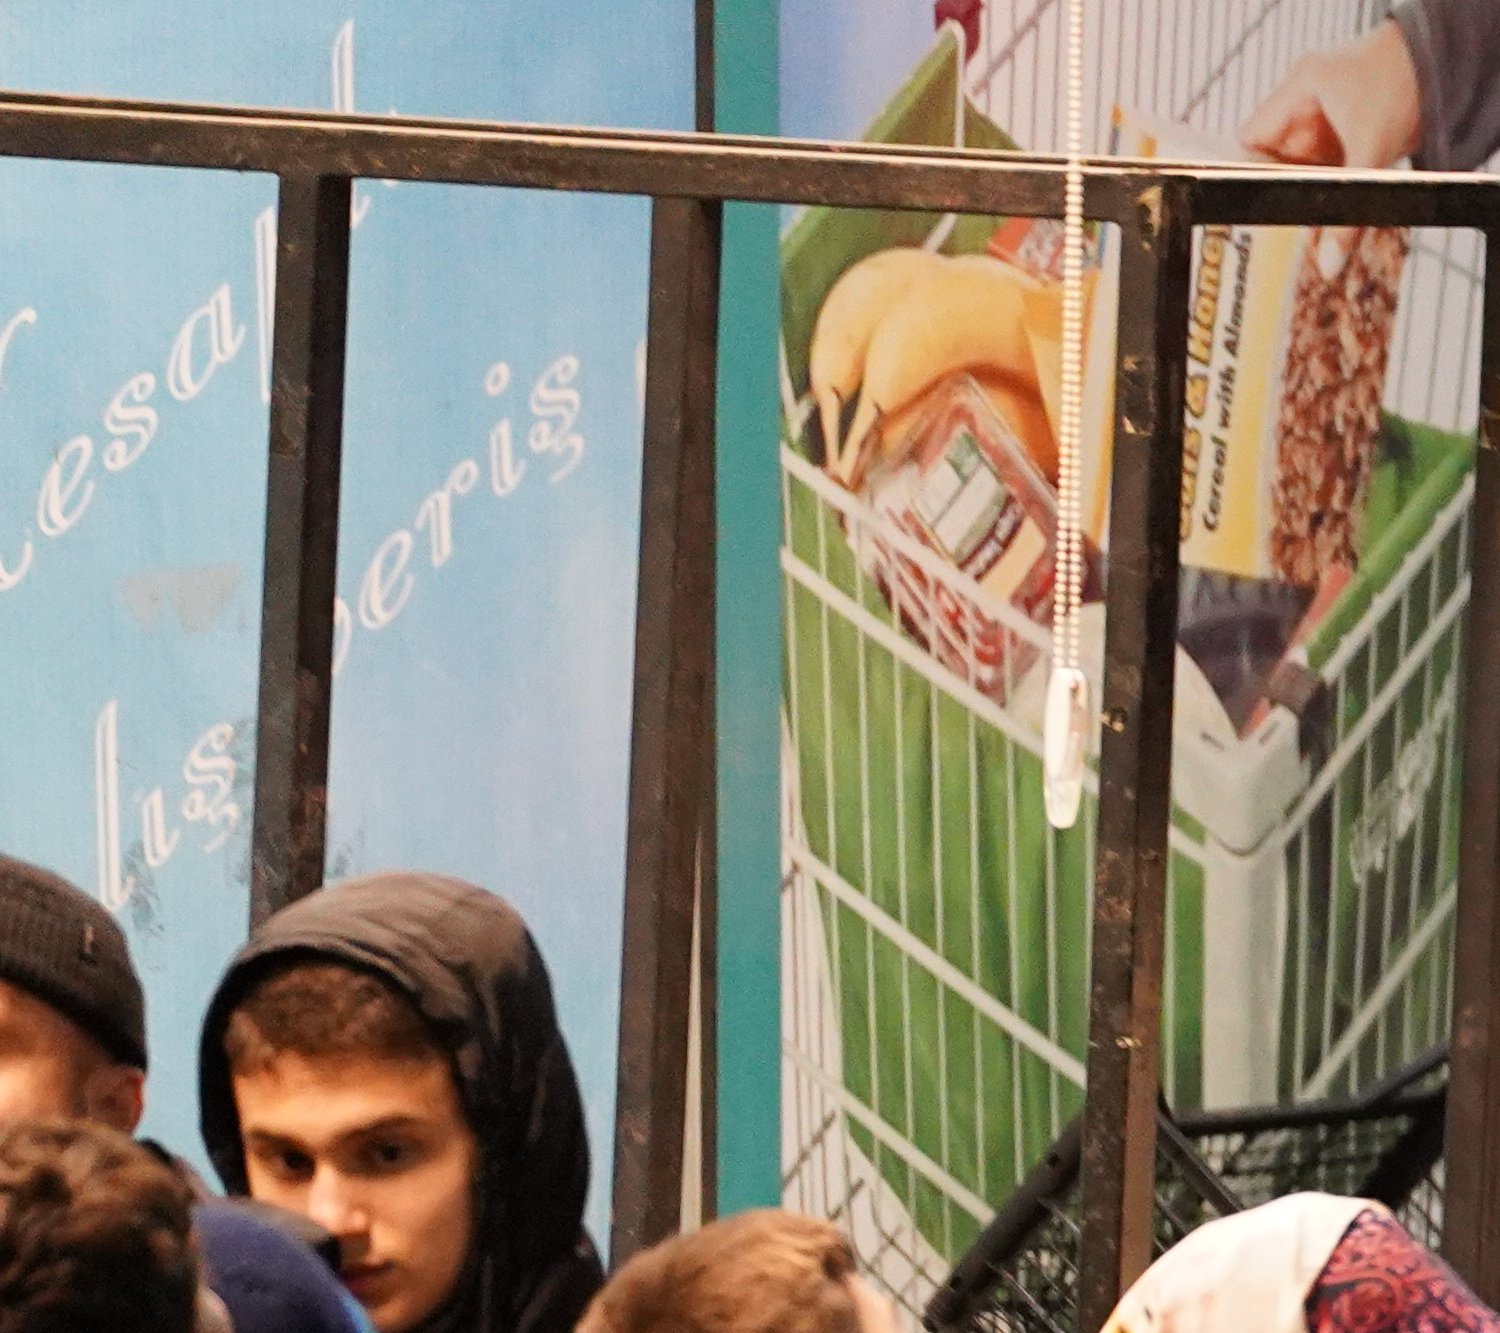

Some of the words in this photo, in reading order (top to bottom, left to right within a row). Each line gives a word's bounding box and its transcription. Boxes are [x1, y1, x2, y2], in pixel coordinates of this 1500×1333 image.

[1223, 231, 1252, 358] Almonds
[1217, 364, 1237, 429] with
[1203, 433, 1227, 531] Cereal
